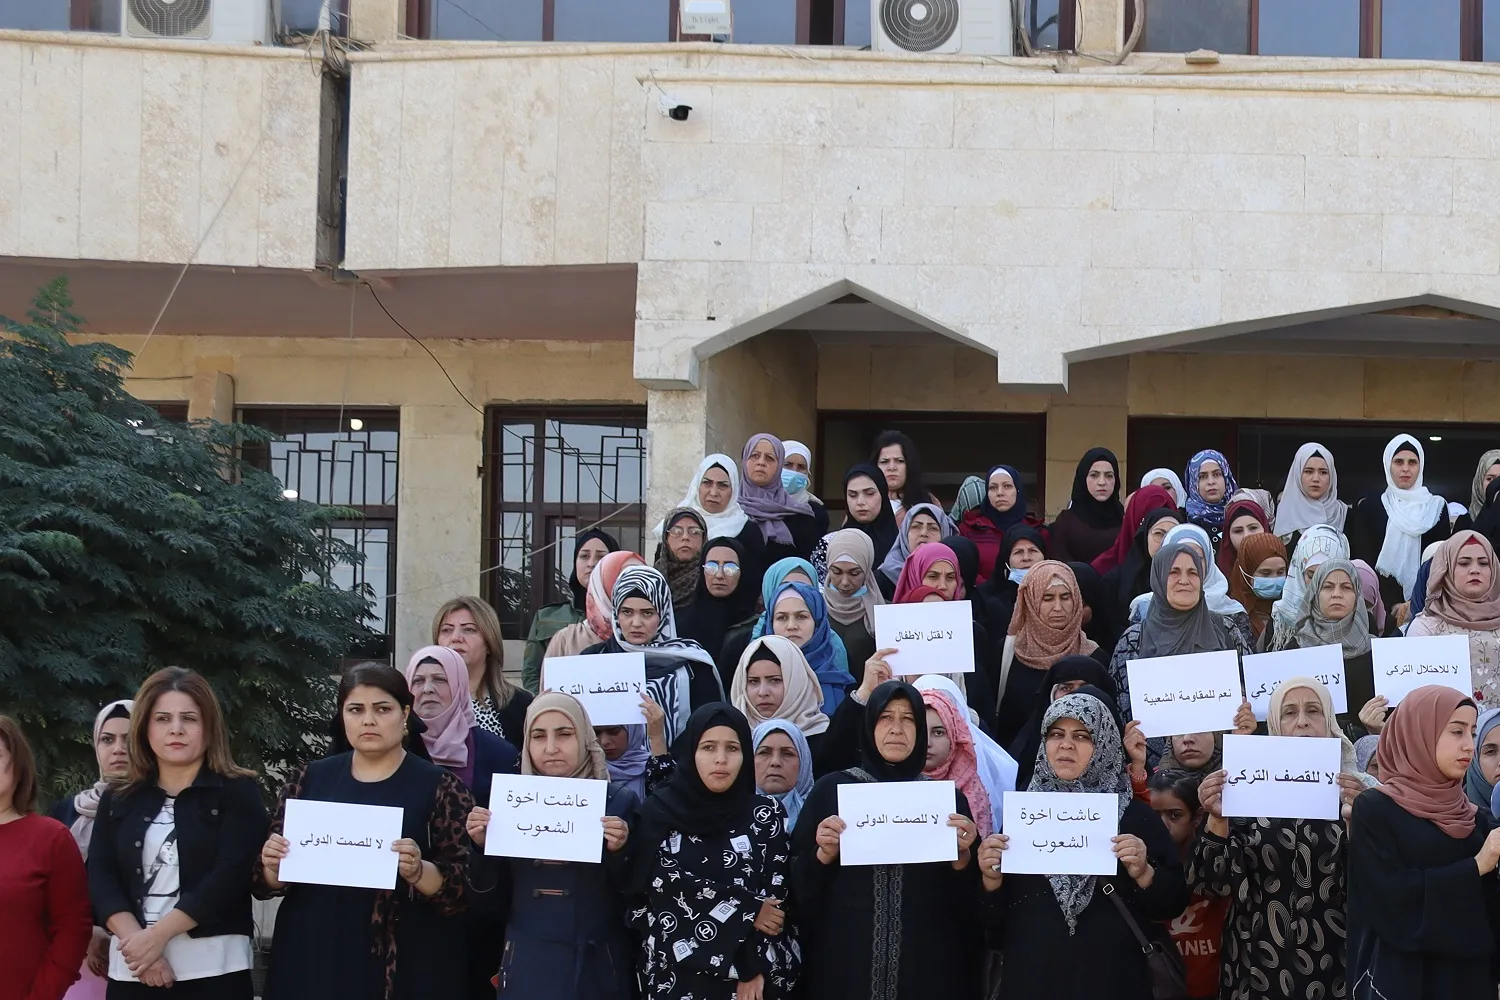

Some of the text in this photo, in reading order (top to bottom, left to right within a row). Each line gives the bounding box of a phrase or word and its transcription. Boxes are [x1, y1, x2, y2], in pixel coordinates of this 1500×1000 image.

[927, 630, 943, 641] لقتل
[947, 631, 953, 639] لا
[1386, 665, 1458, 676] لا للاحتلال التركي
[1332, 673, 1340, 684] لا
[589, 682, 628, 694] للقصف
[632, 682, 642, 693] لا
[1251, 680, 1281, 699] تركي
[1144, 689, 1231, 706] نعم للمقاومة الشعبية
[1227, 769, 1336, 786] لا للقصف التركي
[544, 794, 588, 807] عاشت
[856, 814, 938, 829] لا للصمت الدولي
[1057, 808, 1101, 821] عاشت
[517, 821, 573, 837] الشعوب
[300, 833, 383, 849] لا للصمت الدولي
[1033, 835, 1088, 853] الشعوب
[1176, 939, 1216, 955] NEL
